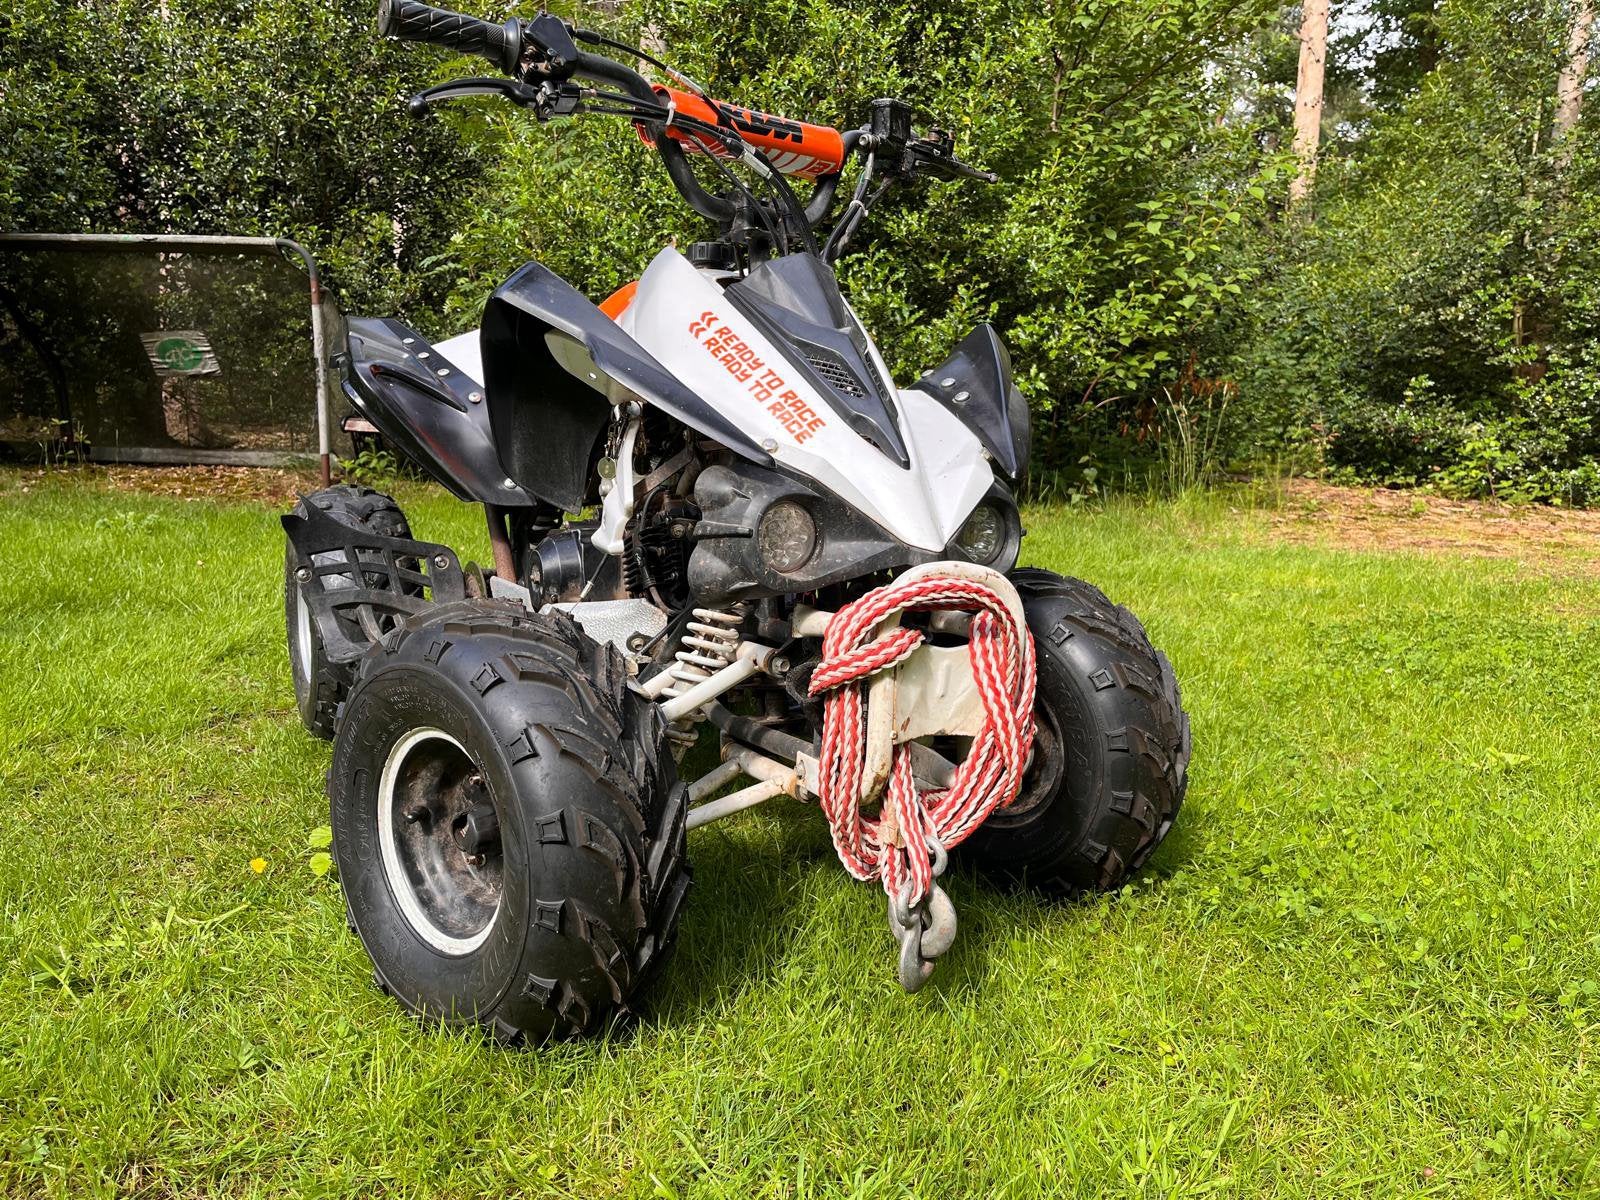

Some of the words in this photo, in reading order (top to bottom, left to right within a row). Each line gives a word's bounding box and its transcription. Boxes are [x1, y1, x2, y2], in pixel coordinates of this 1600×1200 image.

[702, 336, 753, 383] READY
[748, 380, 773, 403] TO
[767, 400, 814, 445] RACE
[714, 326, 765, 371] READY
[761, 368, 785, 391] TO
[779, 389, 827, 433] RACE
